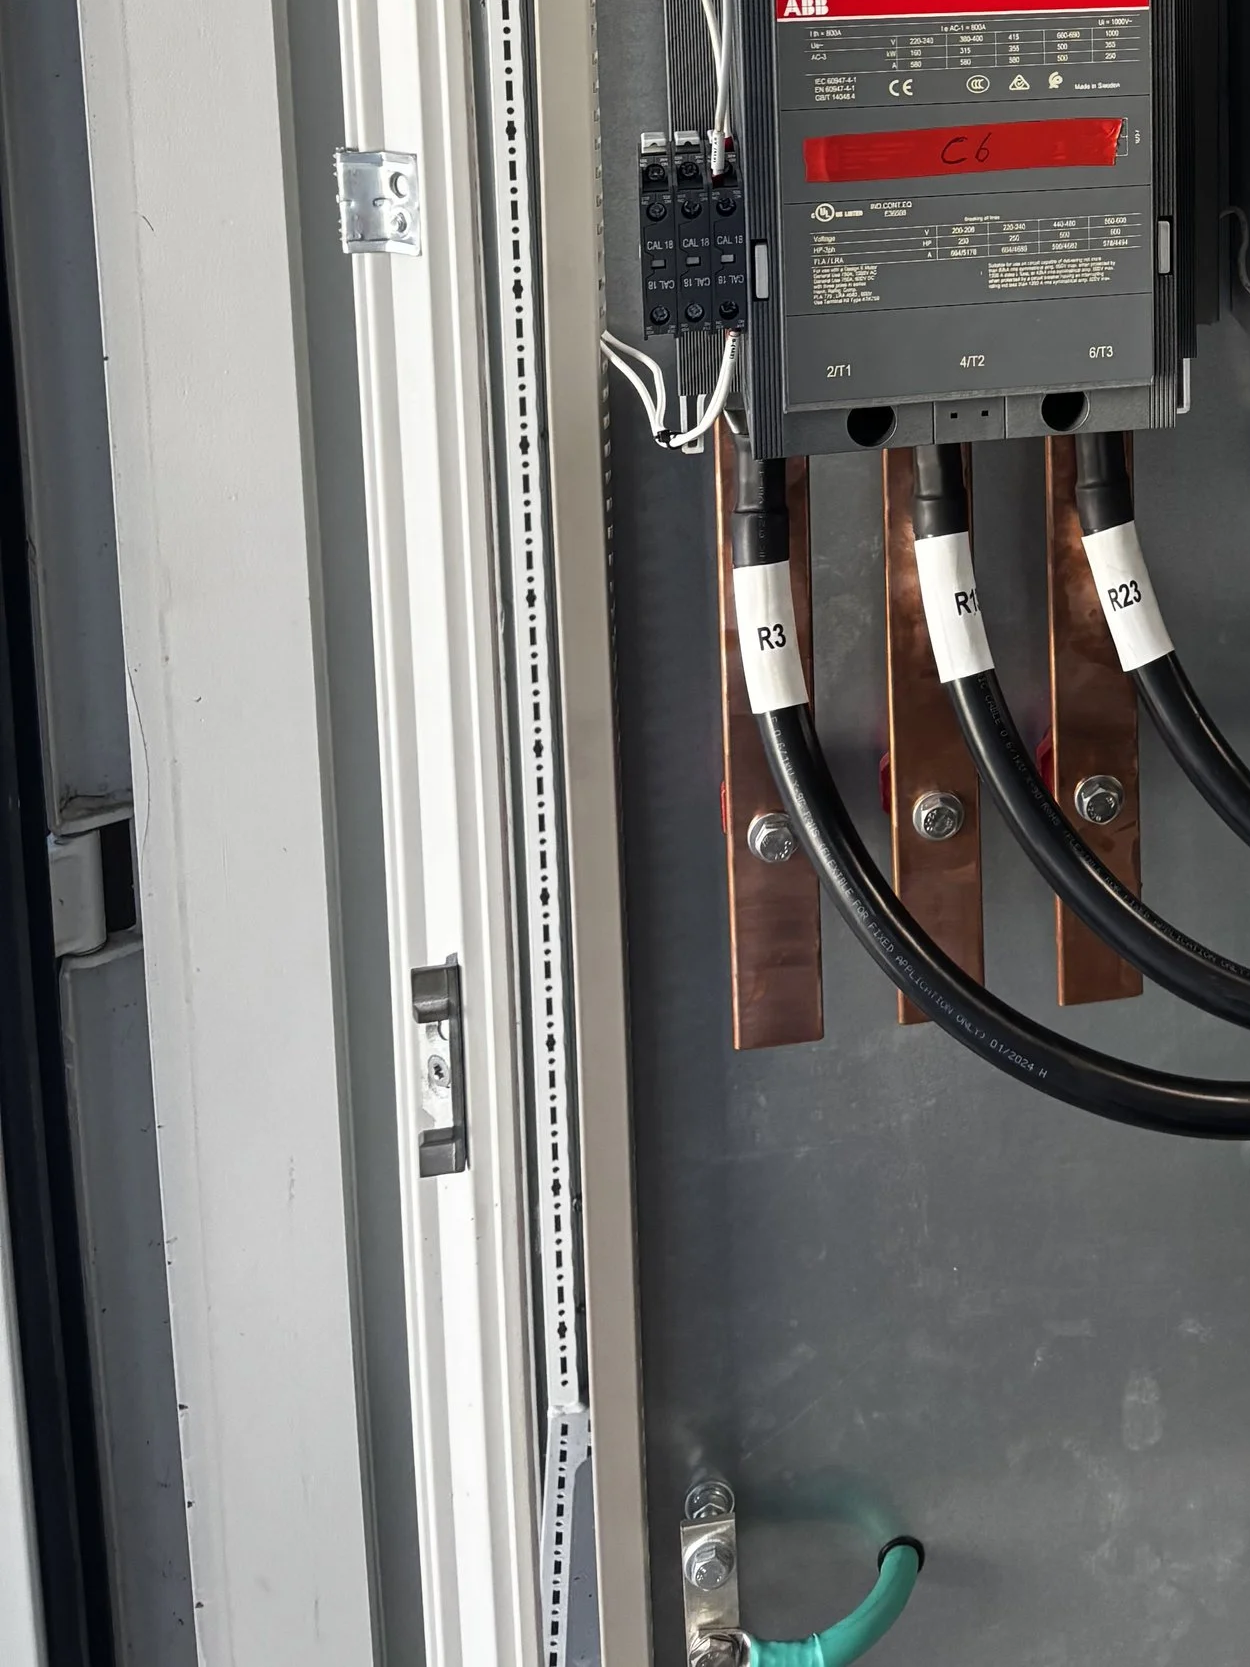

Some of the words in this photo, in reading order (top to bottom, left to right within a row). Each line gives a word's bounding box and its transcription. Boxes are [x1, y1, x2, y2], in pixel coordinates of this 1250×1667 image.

[940, 132, 992, 165] C6
[647, 240, 664, 251] CAL
[682, 238, 699, 248] CAL
[716, 235, 733, 245] CAL
[659, 279, 675, 289] CAL
[695, 277, 711, 286] CAL
[728, 274, 744, 284] CAL
[826, 365, 852, 378] 2/T1
[960, 354, 985, 368] 4/T2
[1089, 346, 1114, 359] 6/T3
[1108, 580, 1142, 612] R23
[757, 623, 787, 651] R3
[852, 899, 869, 919] FOR
[868, 921, 894, 953] FIXED
[895, 955, 953, 1016] APPLICATION
[989, 1038, 1035, 1072] 01/2024
[1038, 1067, 1048, 1078] H
